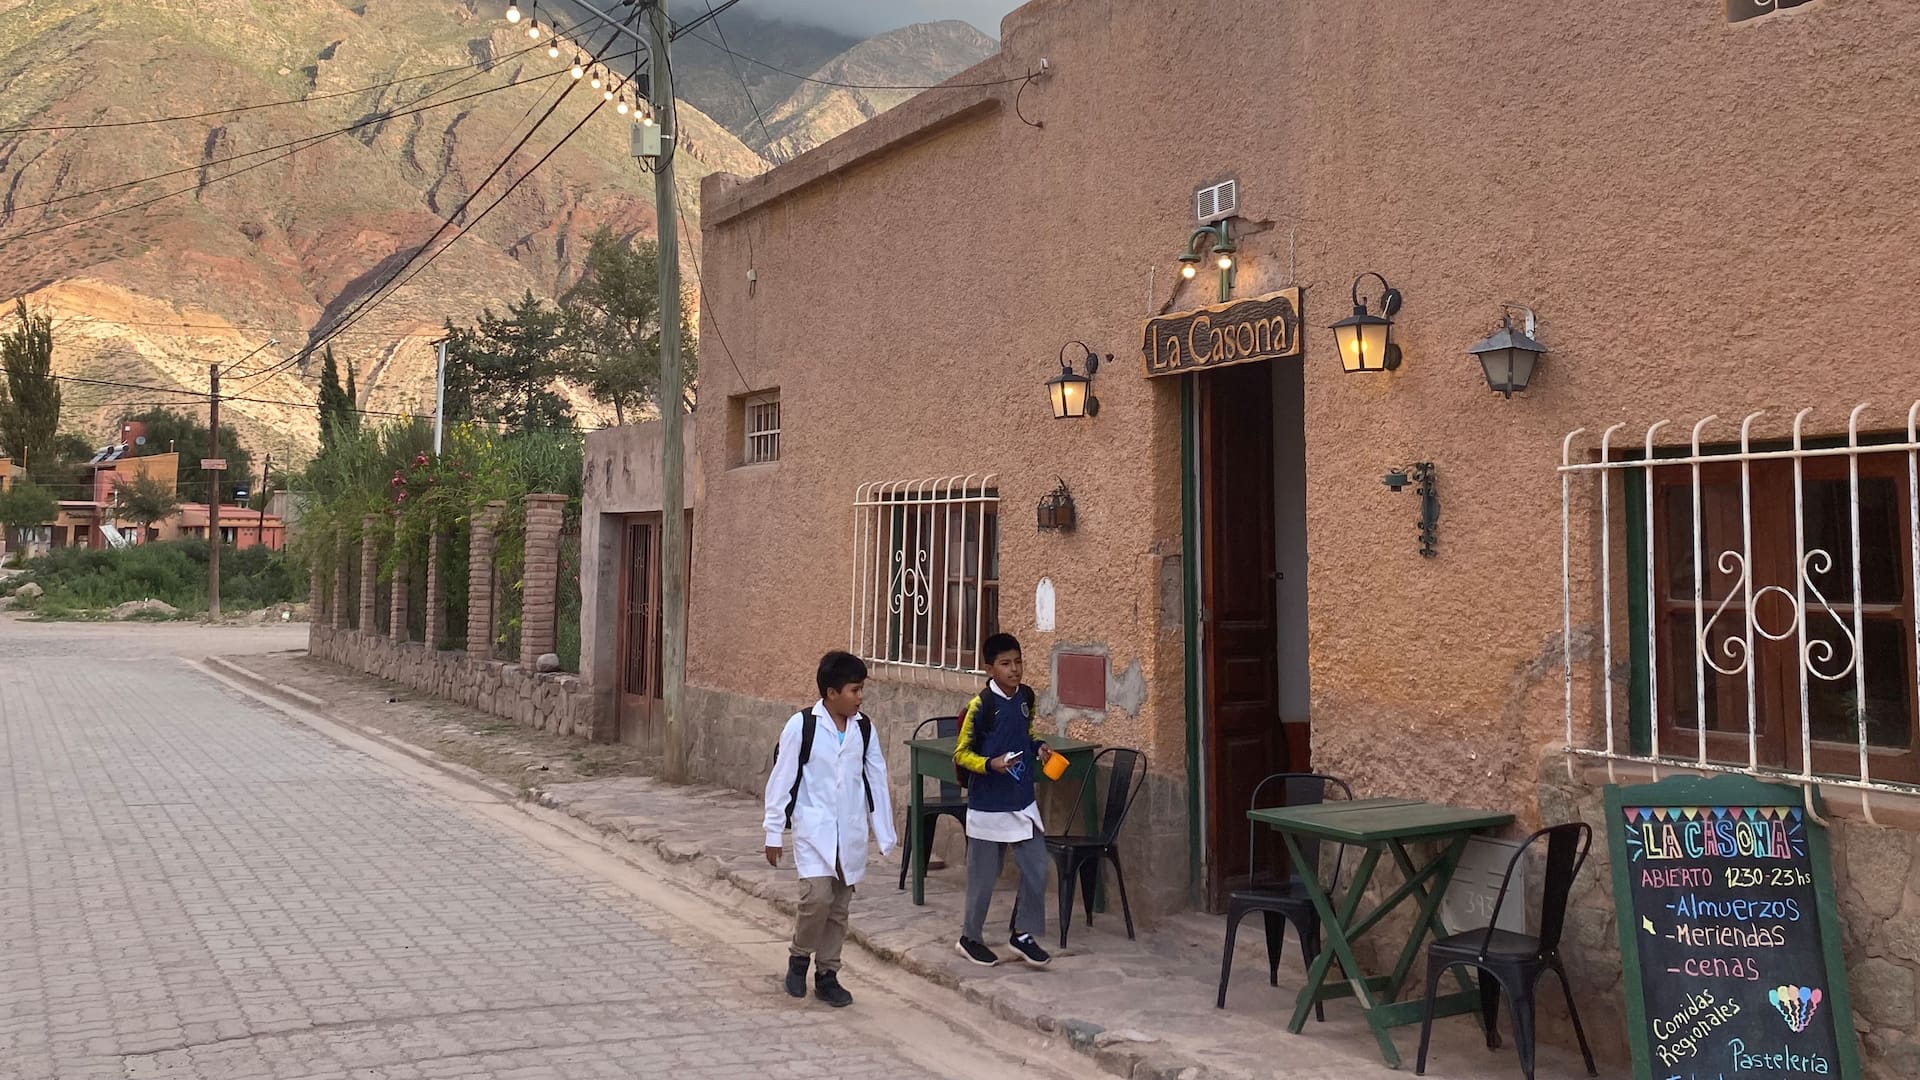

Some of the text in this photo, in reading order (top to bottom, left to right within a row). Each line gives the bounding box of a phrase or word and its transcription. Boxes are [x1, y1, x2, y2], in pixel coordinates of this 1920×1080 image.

[1152, 315, 1287, 369] La Casona
[1642, 819, 1792, 860] LA CASONA
[1641, 867, 1713, 888] ABIERTO
[1653, 988, 1716, 1040] Comidas
[1655, 997, 1741, 1067] Regionales
[1728, 1038, 1829, 1074] Pastelería
